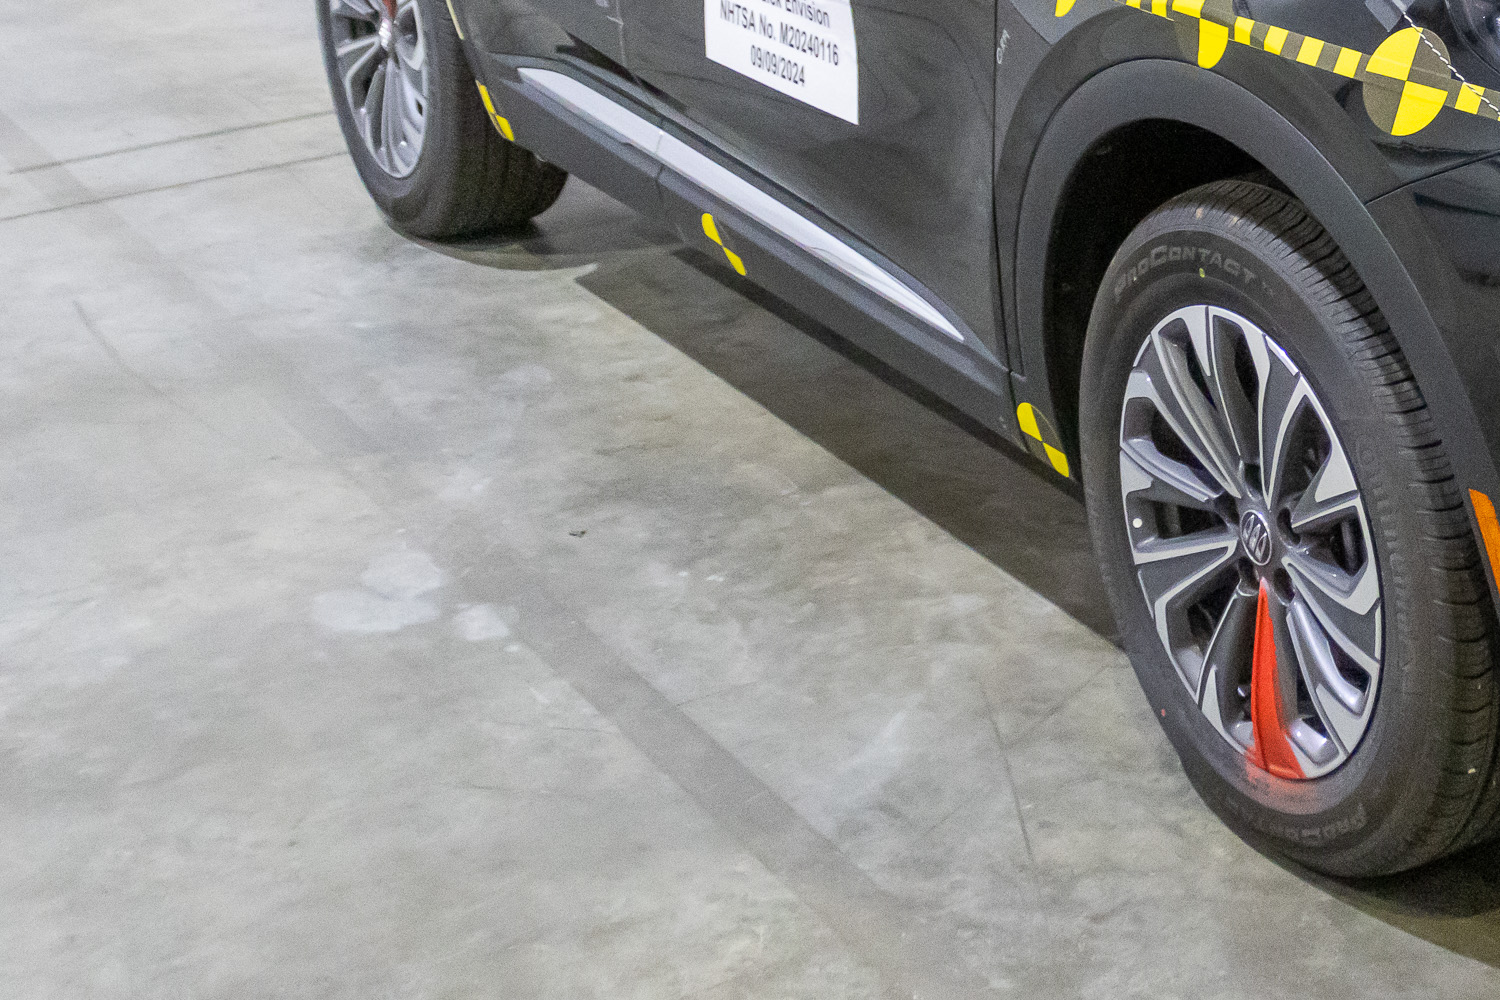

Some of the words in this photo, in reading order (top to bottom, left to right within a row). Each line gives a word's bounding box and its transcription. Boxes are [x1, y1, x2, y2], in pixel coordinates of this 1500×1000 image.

[759, 14, 776, 40] No.
[779, 21, 839, 66] M20240116
[750, 44, 805, 86] 09/09/2024
